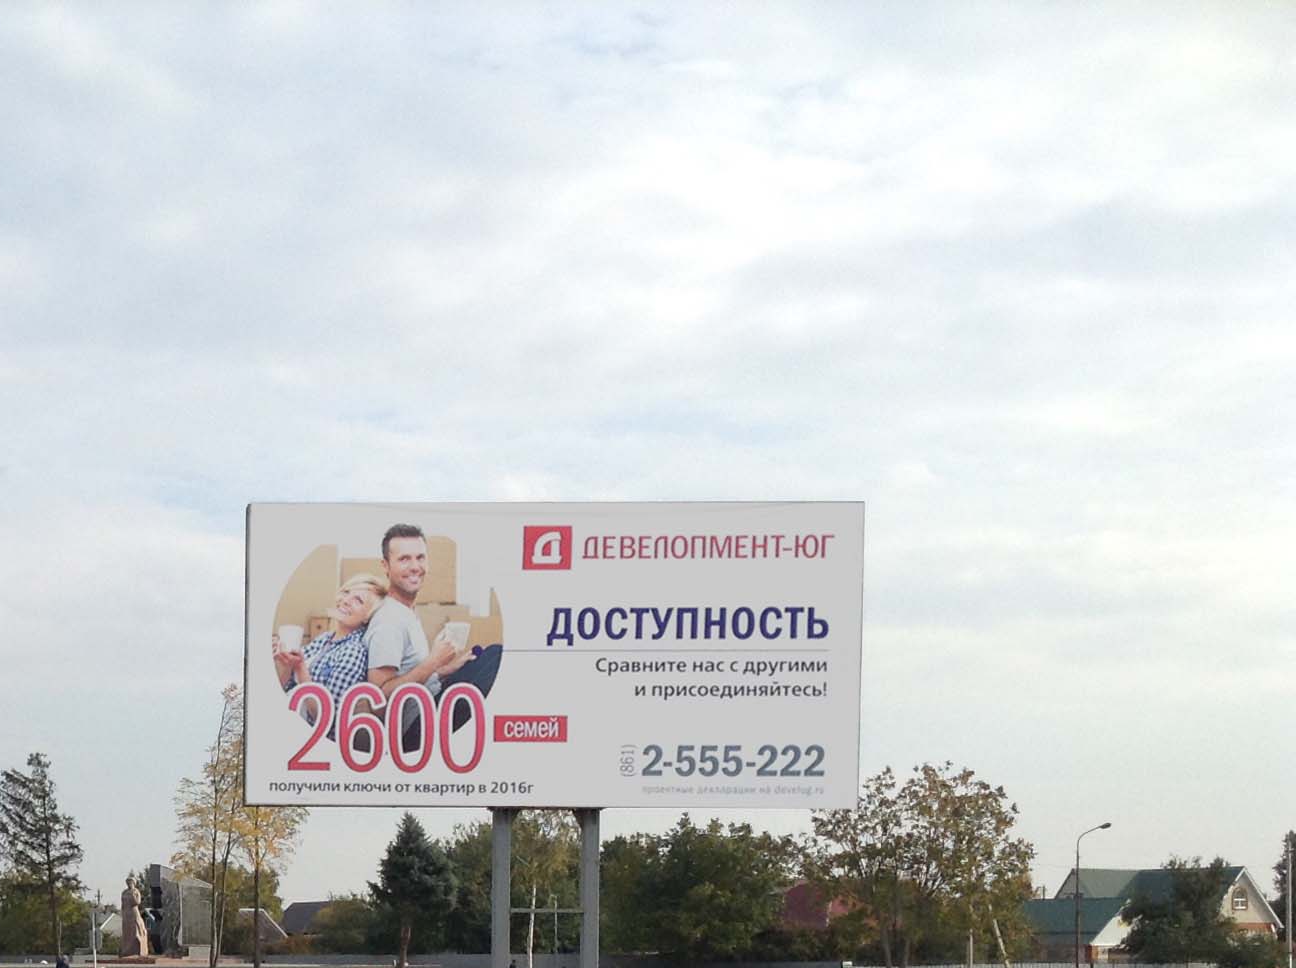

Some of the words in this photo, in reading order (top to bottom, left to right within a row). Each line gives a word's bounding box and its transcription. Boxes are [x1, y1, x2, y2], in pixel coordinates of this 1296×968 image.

[581, 534, 835, 560] ДЕВЕЛОПМЕНТ-ЮГ
[546, 606, 830, 647] ДОСТУПНОСТЬ
[594, 657, 688, 677] Сравните
[692, 660, 725, 673] нас
[729, 660, 739, 673] с
[742, 660, 828, 677] другими
[634, 685, 647, 697] и
[651, 681, 828, 701] присоединяйтесь!
[287, 684, 486, 774] 2600
[503, 716, 560, 738] семей
[619, 744, 638, 778] (861)
[641, 743, 826, 778] 2-555-222
[269, 781, 341, 796] получили
[343, 782, 392, 793] ключи
[394, 783, 411, 793] от
[414, 783, 476, 797] квартир
[478, 783, 487, 793] в
[490, 781, 535, 794] 2016г
